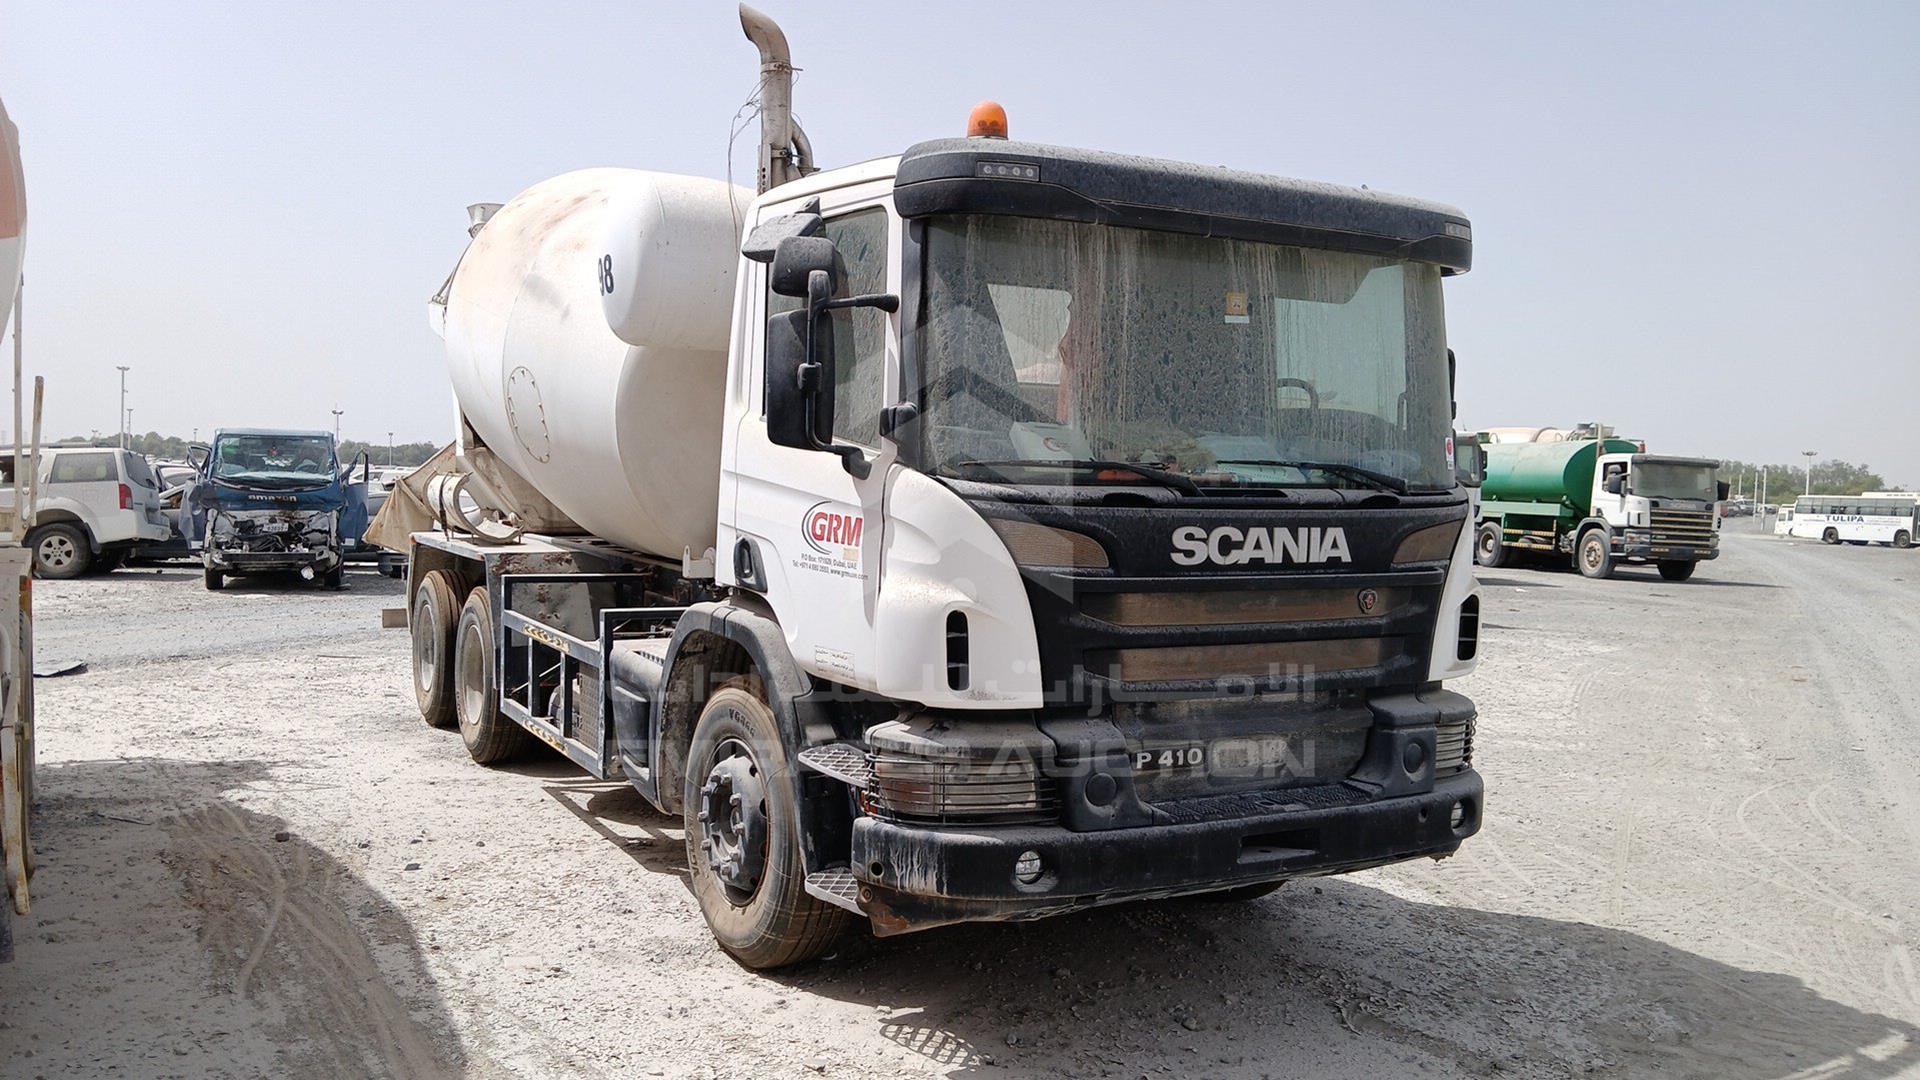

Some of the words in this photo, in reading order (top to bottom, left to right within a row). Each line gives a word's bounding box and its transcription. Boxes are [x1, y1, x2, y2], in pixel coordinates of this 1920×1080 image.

[811, 511, 863, 547] GRM
[1825, 515, 1865, 523] TULIPA
[1169, 525, 1352, 566] SCANIA
[1135, 752, 1152, 769] P
[1158, 747, 1203, 767] 410
